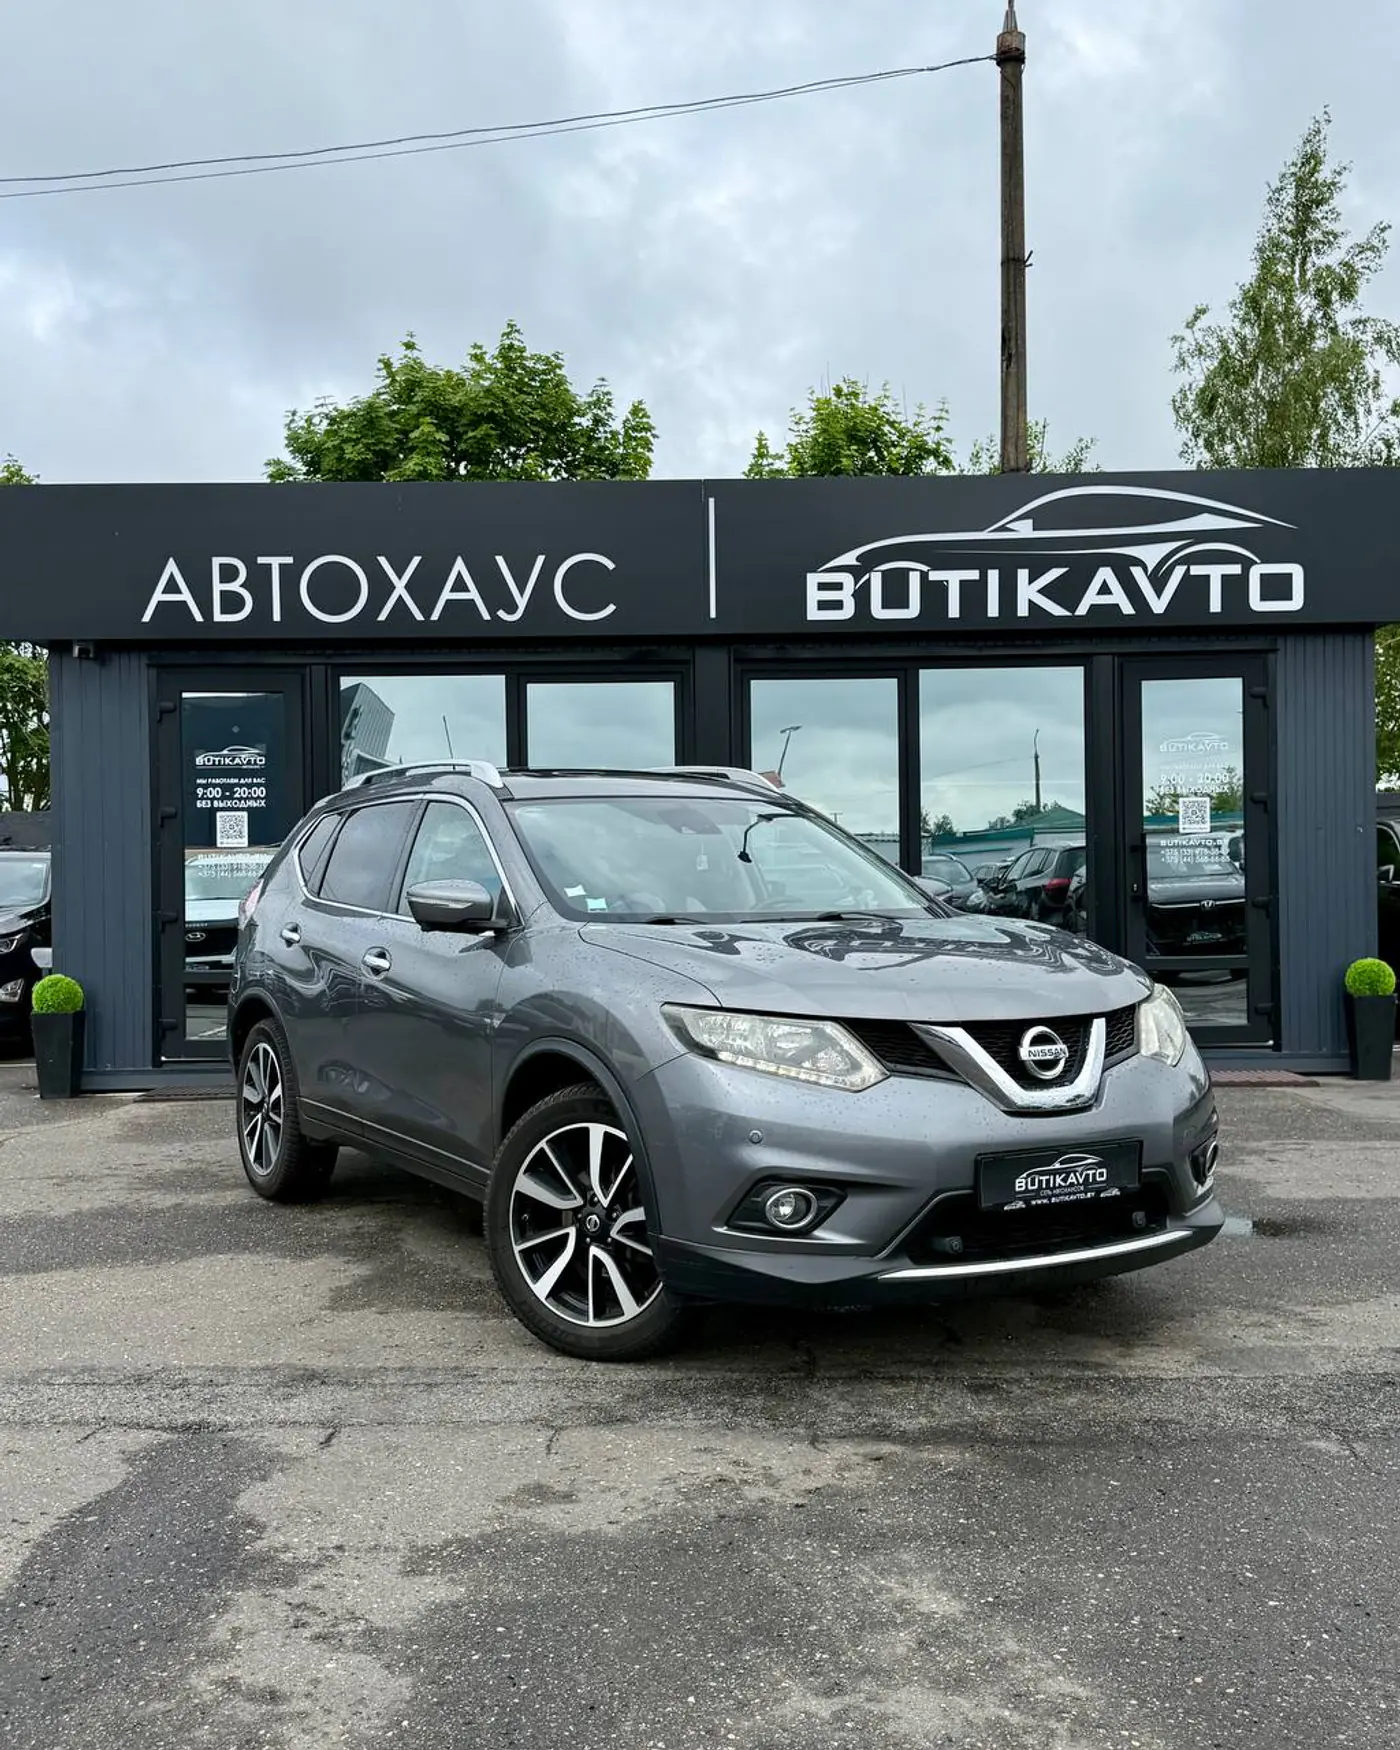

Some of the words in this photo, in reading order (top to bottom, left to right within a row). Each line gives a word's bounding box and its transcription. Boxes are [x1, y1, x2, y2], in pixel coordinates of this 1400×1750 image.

[141, 553, 617, 623] АВТОХАУС
[806, 563, 1304, 621] BUTIKAVTO
[1160, 742, 1229, 752] BUTIKAVTO
[195, 756, 266, 765] BUTIKAVTO
[1161, 773, 1185, 784] 9:00
[196, 787, 222, 798] 9:00
[233, 787, 267, 798] 20:00
[196, 800, 211, 808] БЕЗ
[213, 800, 267, 808] ВЫХОДНЫХ
[1028, 1047, 1066, 1058] NISSAN
[1015, 1168, 1107, 1191] BUTIKAVTO
